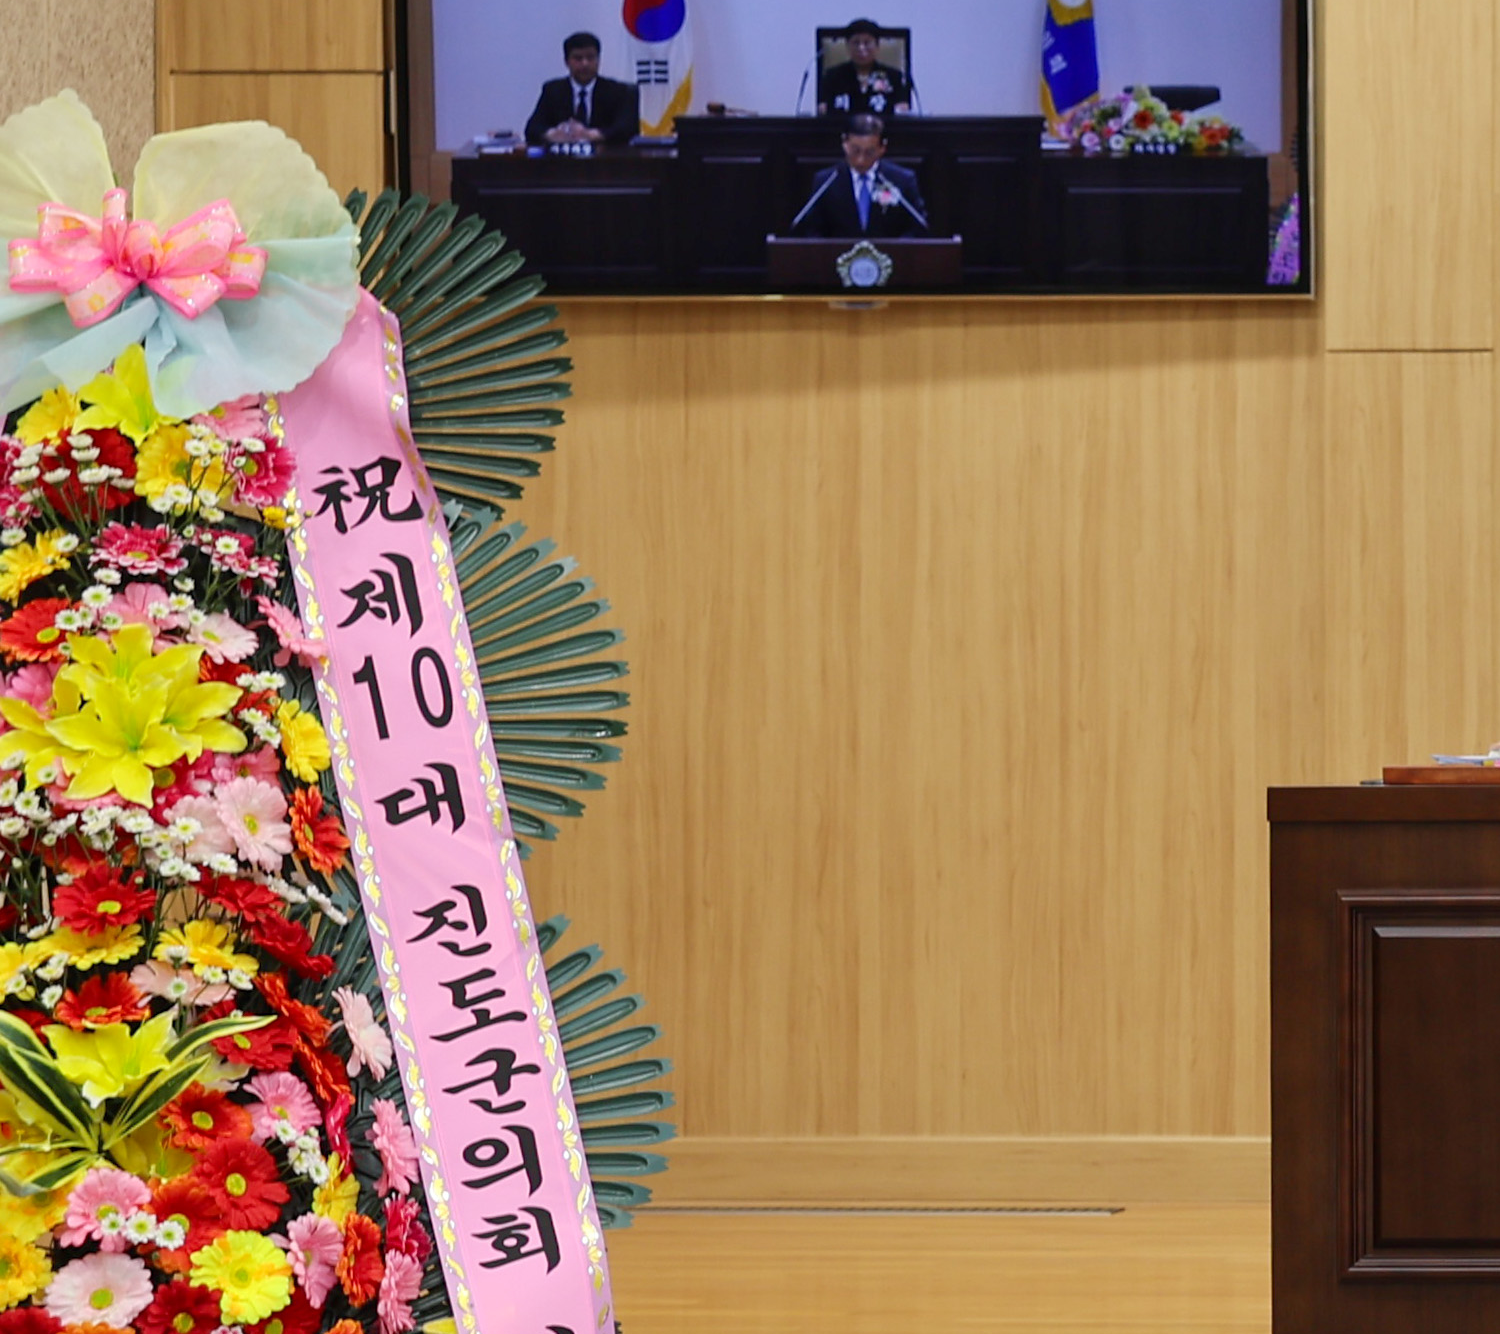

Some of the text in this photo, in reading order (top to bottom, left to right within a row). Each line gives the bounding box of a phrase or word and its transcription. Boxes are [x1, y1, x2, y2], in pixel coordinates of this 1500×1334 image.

[312, 456, 424, 535] 祝
[336, 551, 467, 836] 제10대
[405, 883, 563, 1275] 진도군의회
